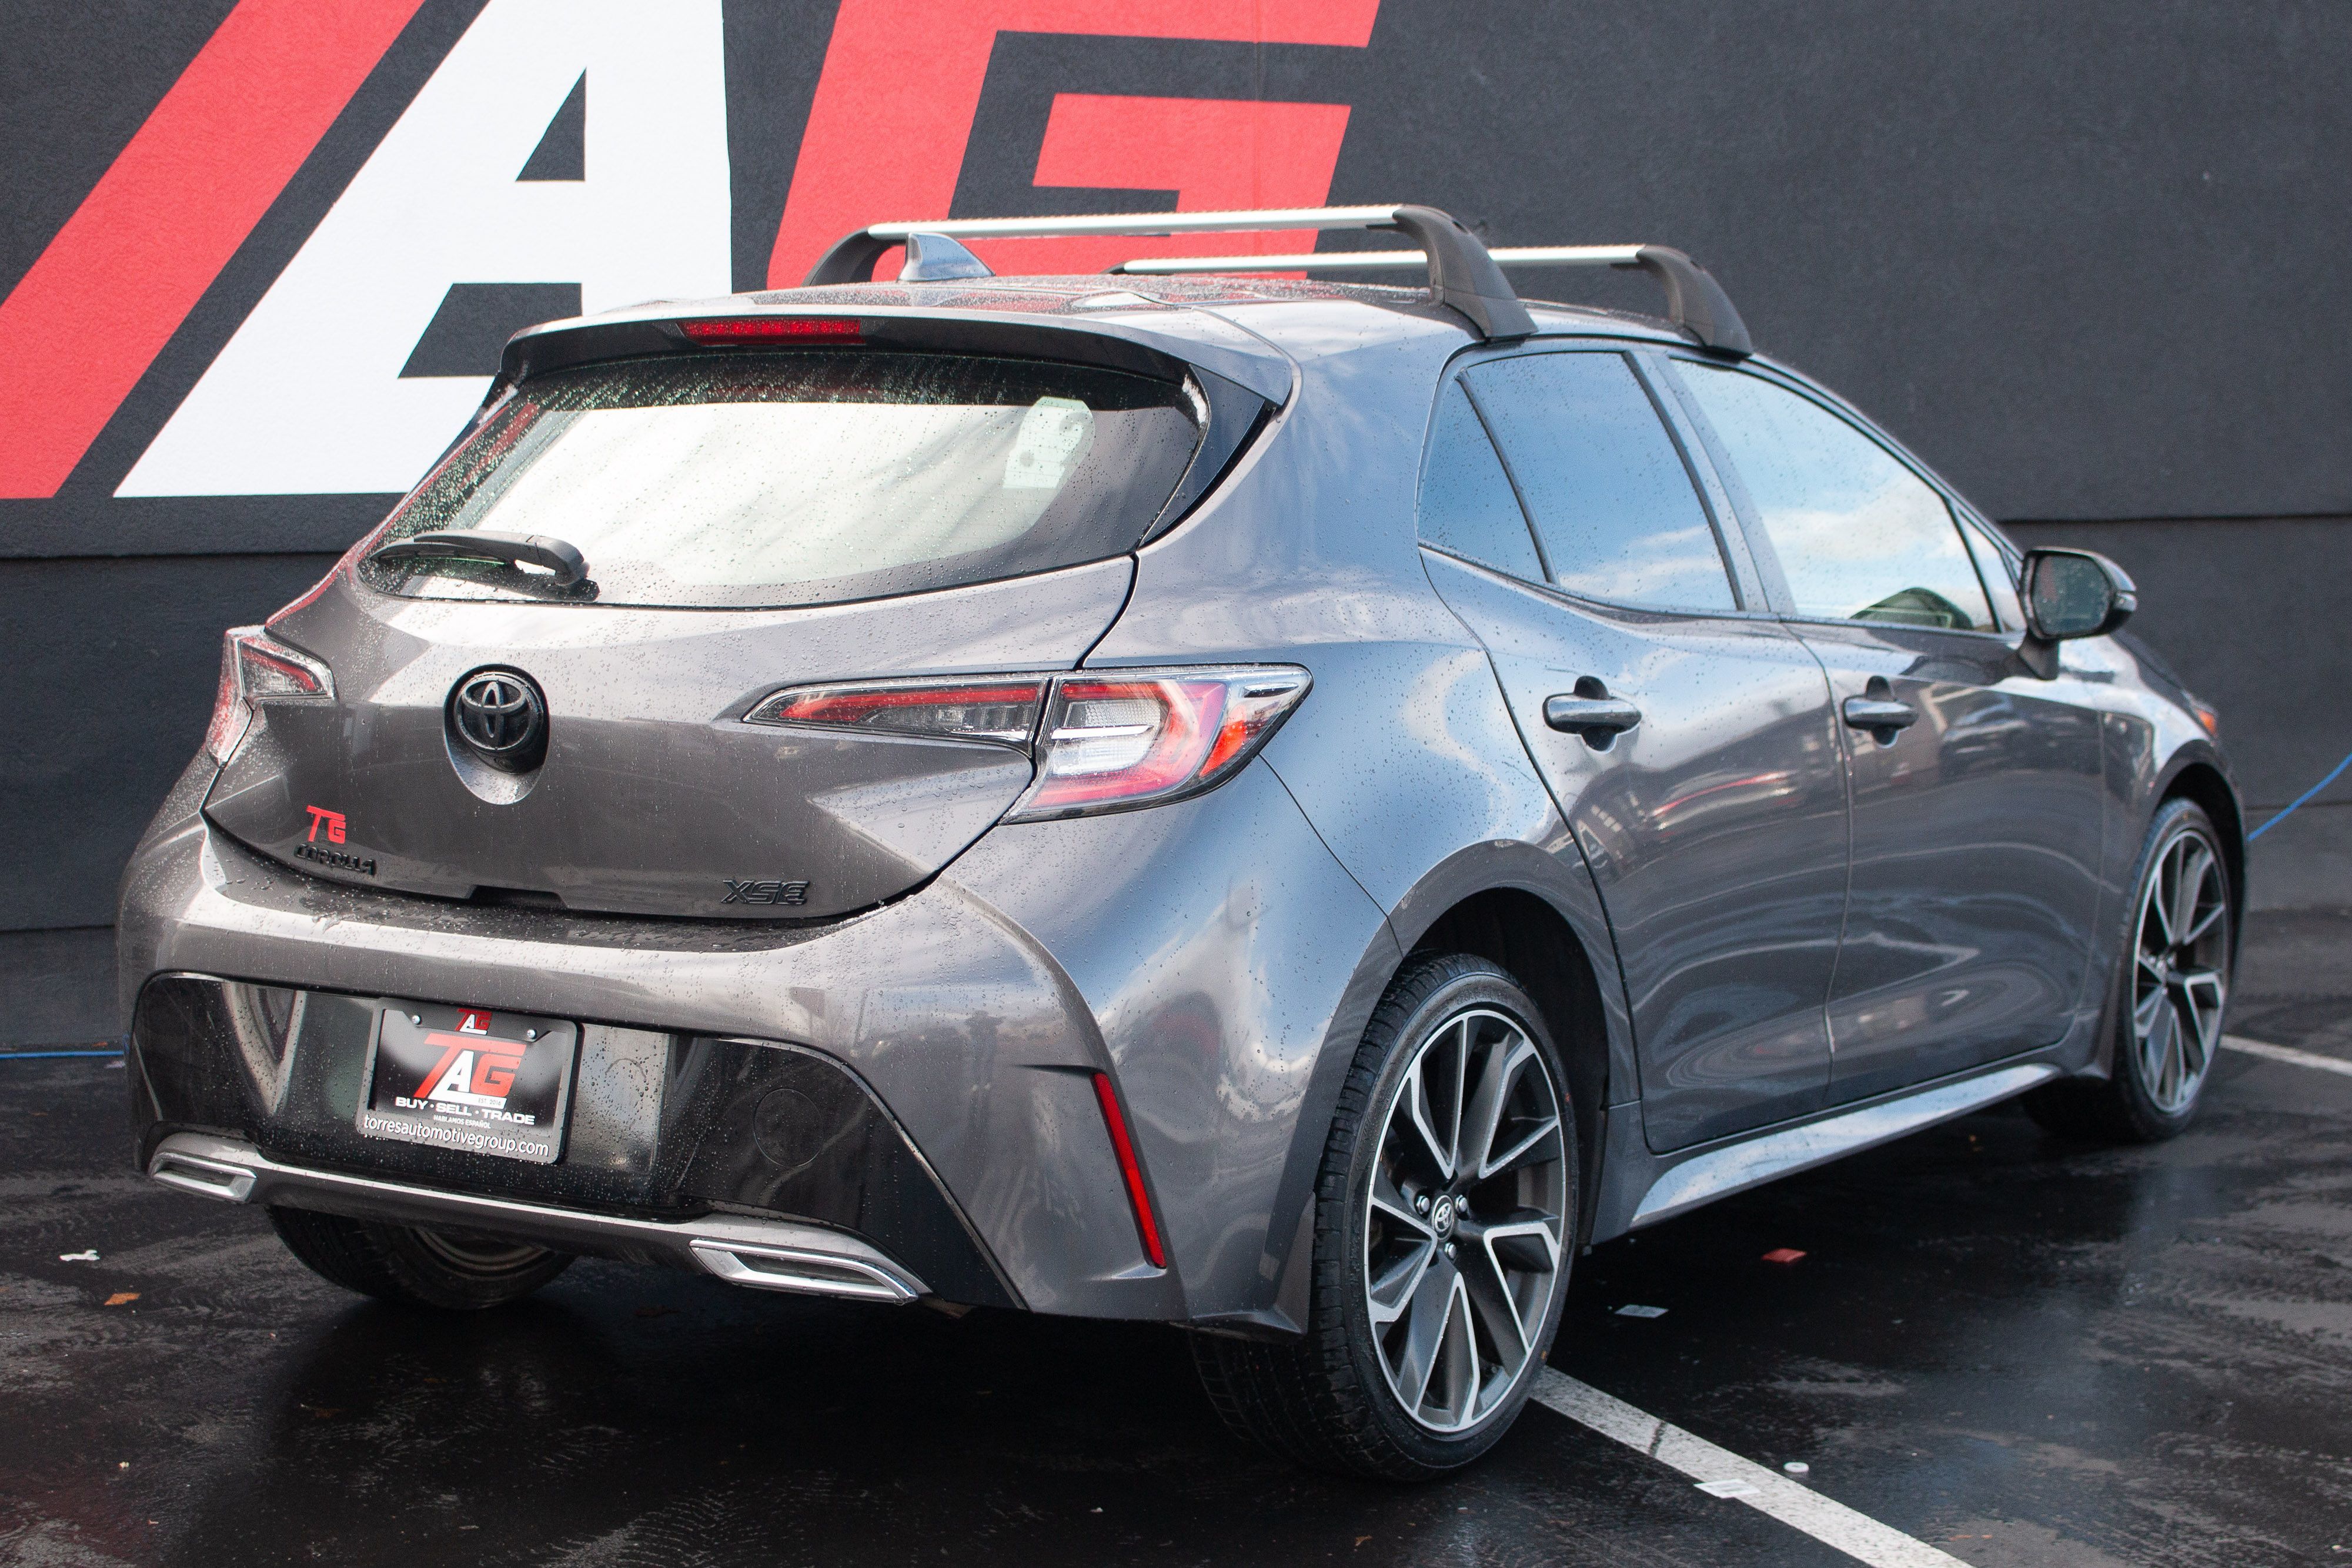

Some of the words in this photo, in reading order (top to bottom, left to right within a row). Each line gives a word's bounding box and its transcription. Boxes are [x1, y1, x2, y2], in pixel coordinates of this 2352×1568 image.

[721, 880, 809, 905] XSE
[455, 1008, 492, 1035] TAG
[413, 1033, 526, 1109] TAG
[395, 1097, 429, 1110] BUY
[435, 1102, 472, 1116] SELL
[482, 1109, 536, 1125] TRADE
[433, 1114, 465, 1125] HABLAMOS
[465, 1119, 492, 1129] ESPAÑOL
[363, 1114, 550, 1156] torresautomotivegroup.com
